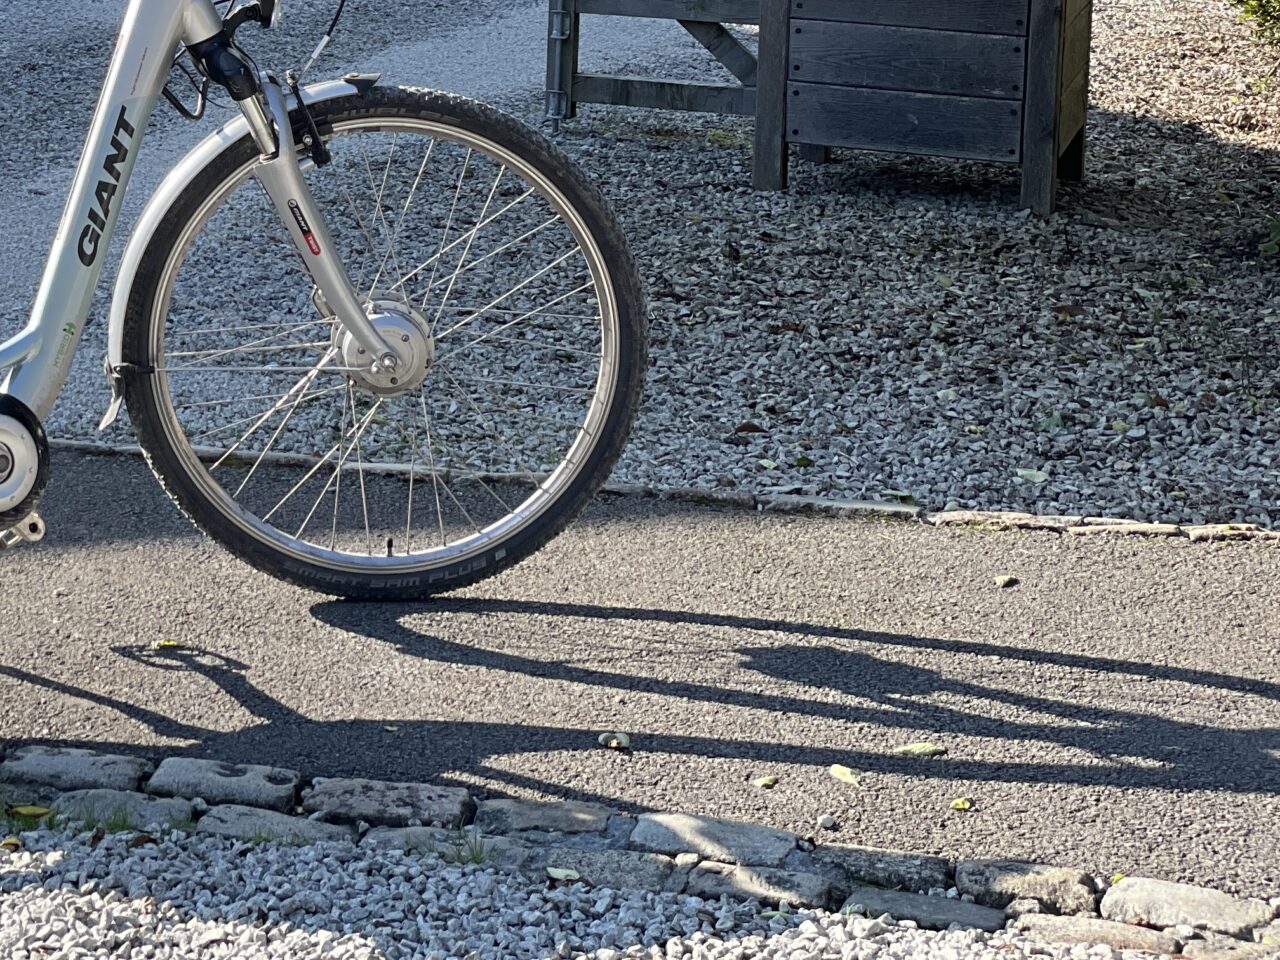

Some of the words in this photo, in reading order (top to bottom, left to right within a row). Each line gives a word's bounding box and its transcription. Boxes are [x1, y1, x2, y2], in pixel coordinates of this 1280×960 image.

[77, 104, 135, 268] GIANT
[293, 207, 309, 231] GIANT
[281, 561, 365, 587] SMART
[369, 576, 420, 589] SAM
[428, 557, 487, 584] PLUS
